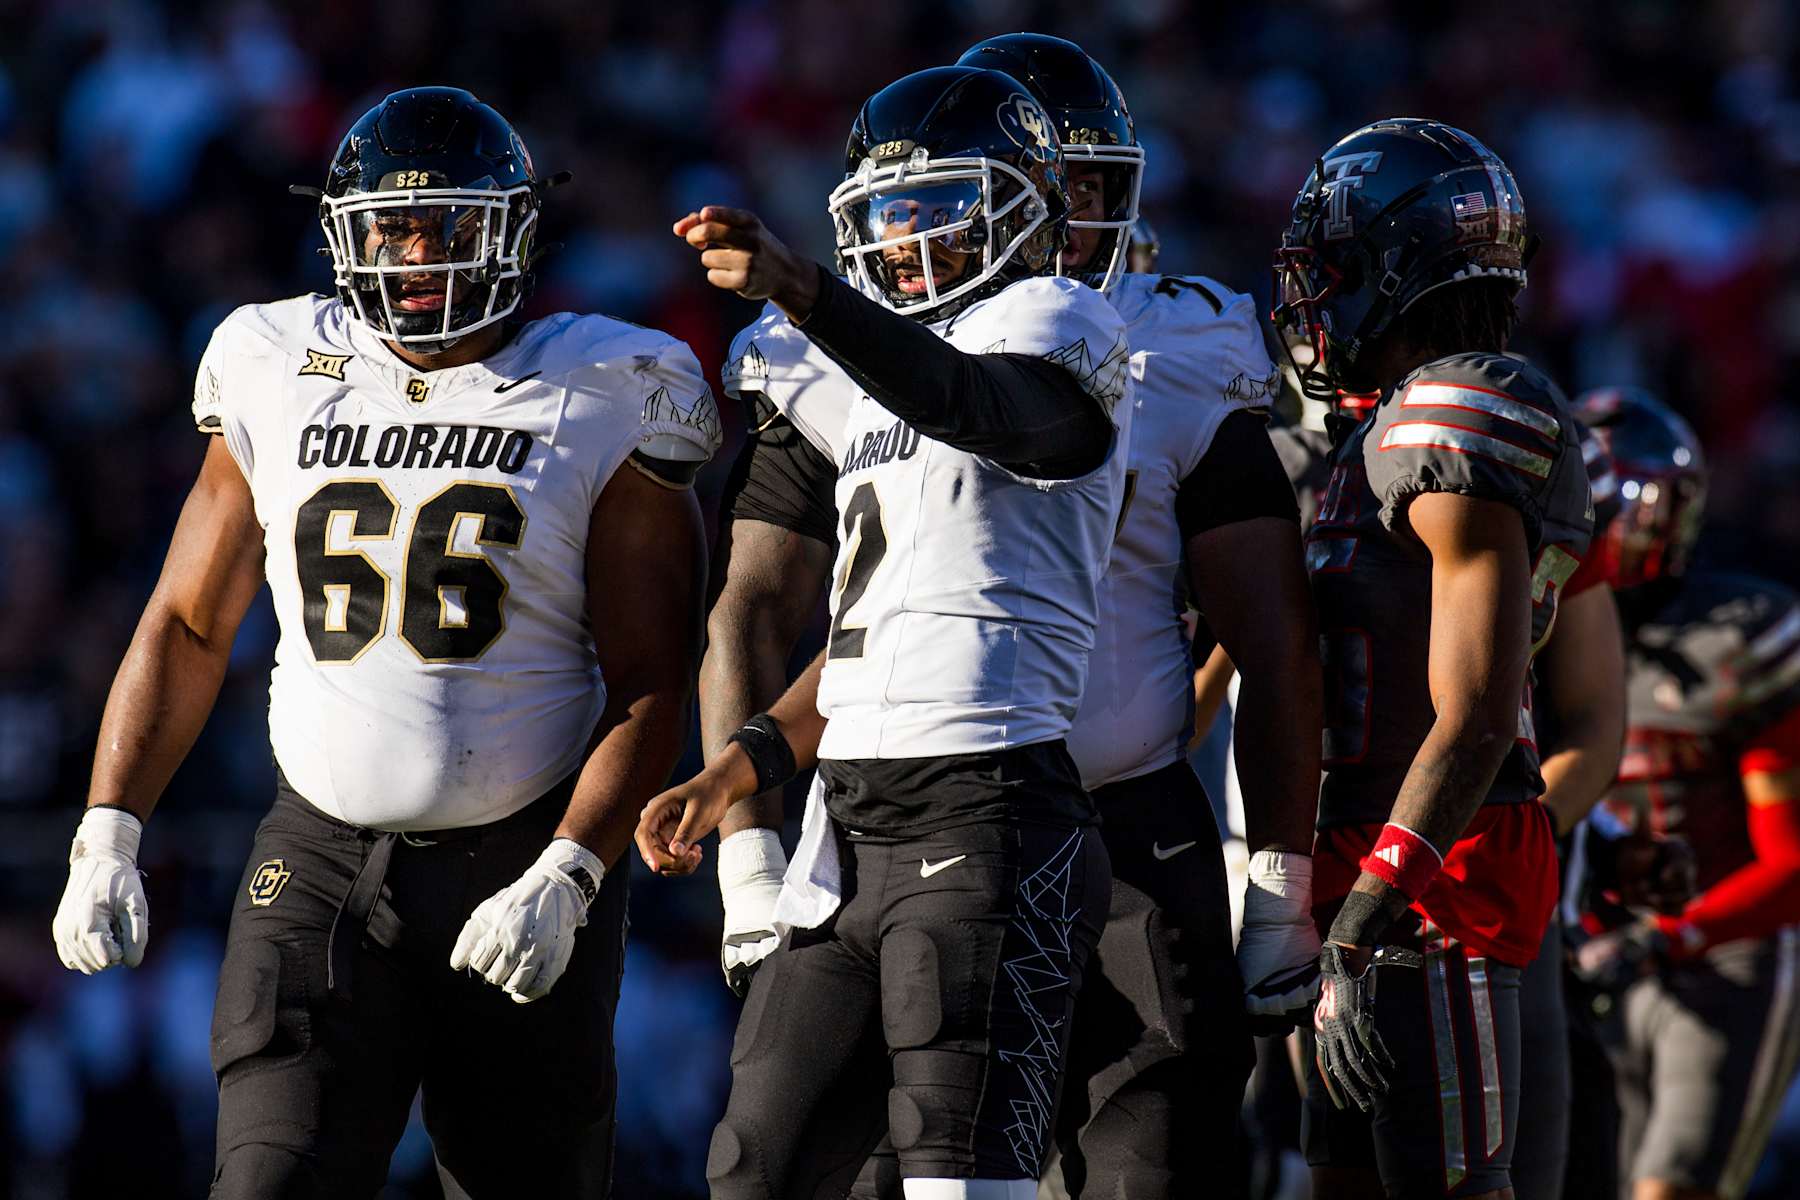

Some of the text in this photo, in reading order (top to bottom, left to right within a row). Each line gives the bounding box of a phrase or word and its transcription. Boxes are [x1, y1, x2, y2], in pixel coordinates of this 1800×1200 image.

[406, 378, 430, 403] CU
[298, 424, 534, 474] COLORADO
[292, 478, 529, 666] 66
[828, 480, 888, 661] 2
[249, 858, 292, 906] CU
